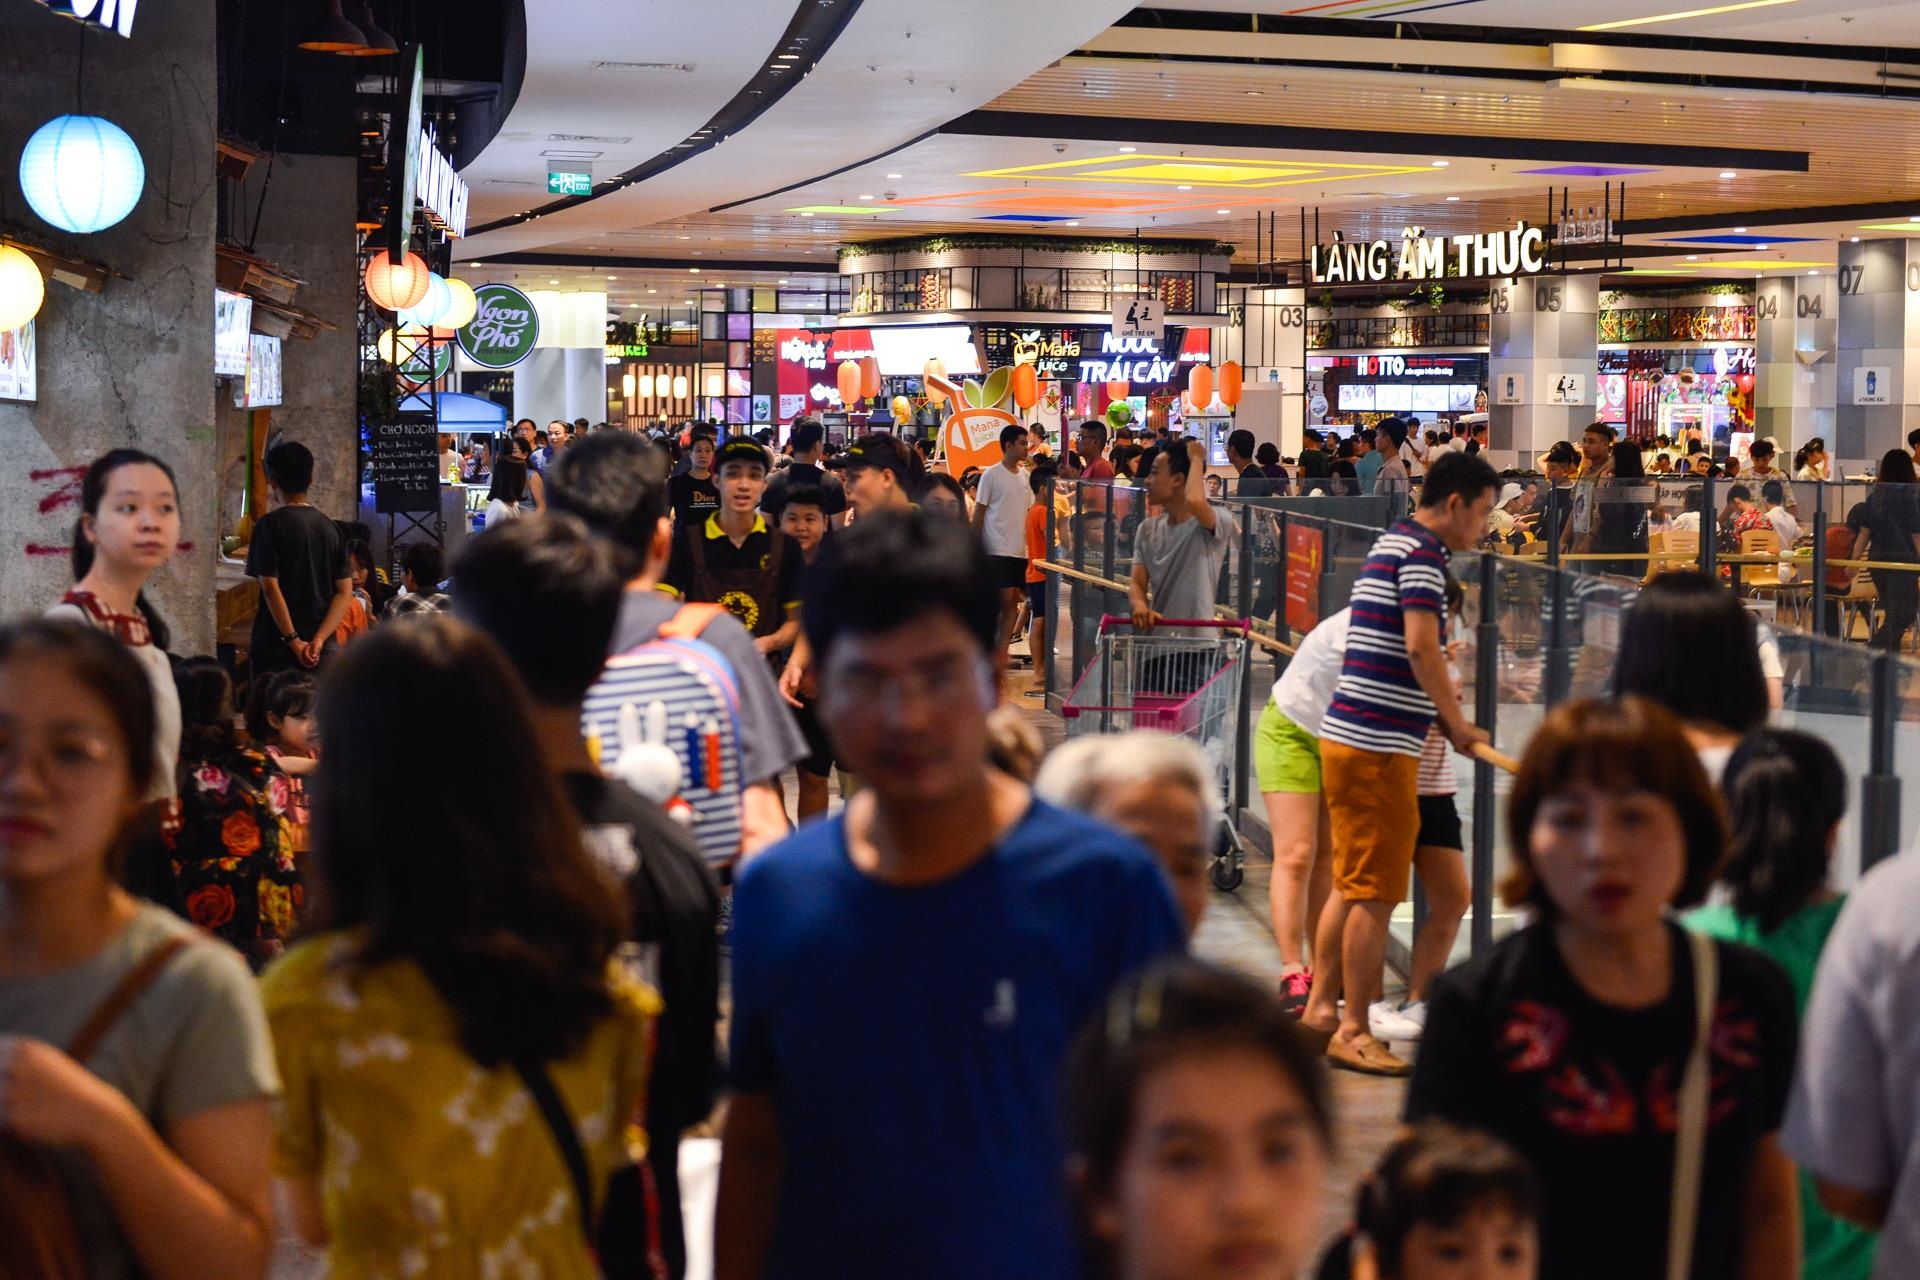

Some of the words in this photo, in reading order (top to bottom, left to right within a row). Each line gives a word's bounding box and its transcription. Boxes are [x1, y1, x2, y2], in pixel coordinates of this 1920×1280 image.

[575, 183, 590, 191] EXIT
[1311, 230, 1388, 283] LÀNG
[1452, 220, 1543, 285] THỰC
[1838, 264, 1865, 297] 07
[1490, 287, 1509, 313] 05
[1535, 286, 1562, 312] 05
[1756, 294, 1777, 320] 04
[1797, 294, 1822, 319] 04
[476, 295, 529, 328] Ngon
[1230, 306, 1244, 328] 03
[1280, 306, 1303, 328] 03
[469, 321, 524, 354] Phố
[1040, 341, 1081, 357] Mana
[1037, 357, 1068, 376] juice
[1079, 355, 1131, 383] TRÁI
[1132, 355, 1177, 383] CÂY
[1357, 356, 1405, 376] HOTTO
[380, 423, 403, 436] CHỢ
[404, 424, 435, 435] NGON
[970, 419, 1000, 434] Mana
[975, 432, 994, 447] juice
[692, 490, 716, 502] Dior
